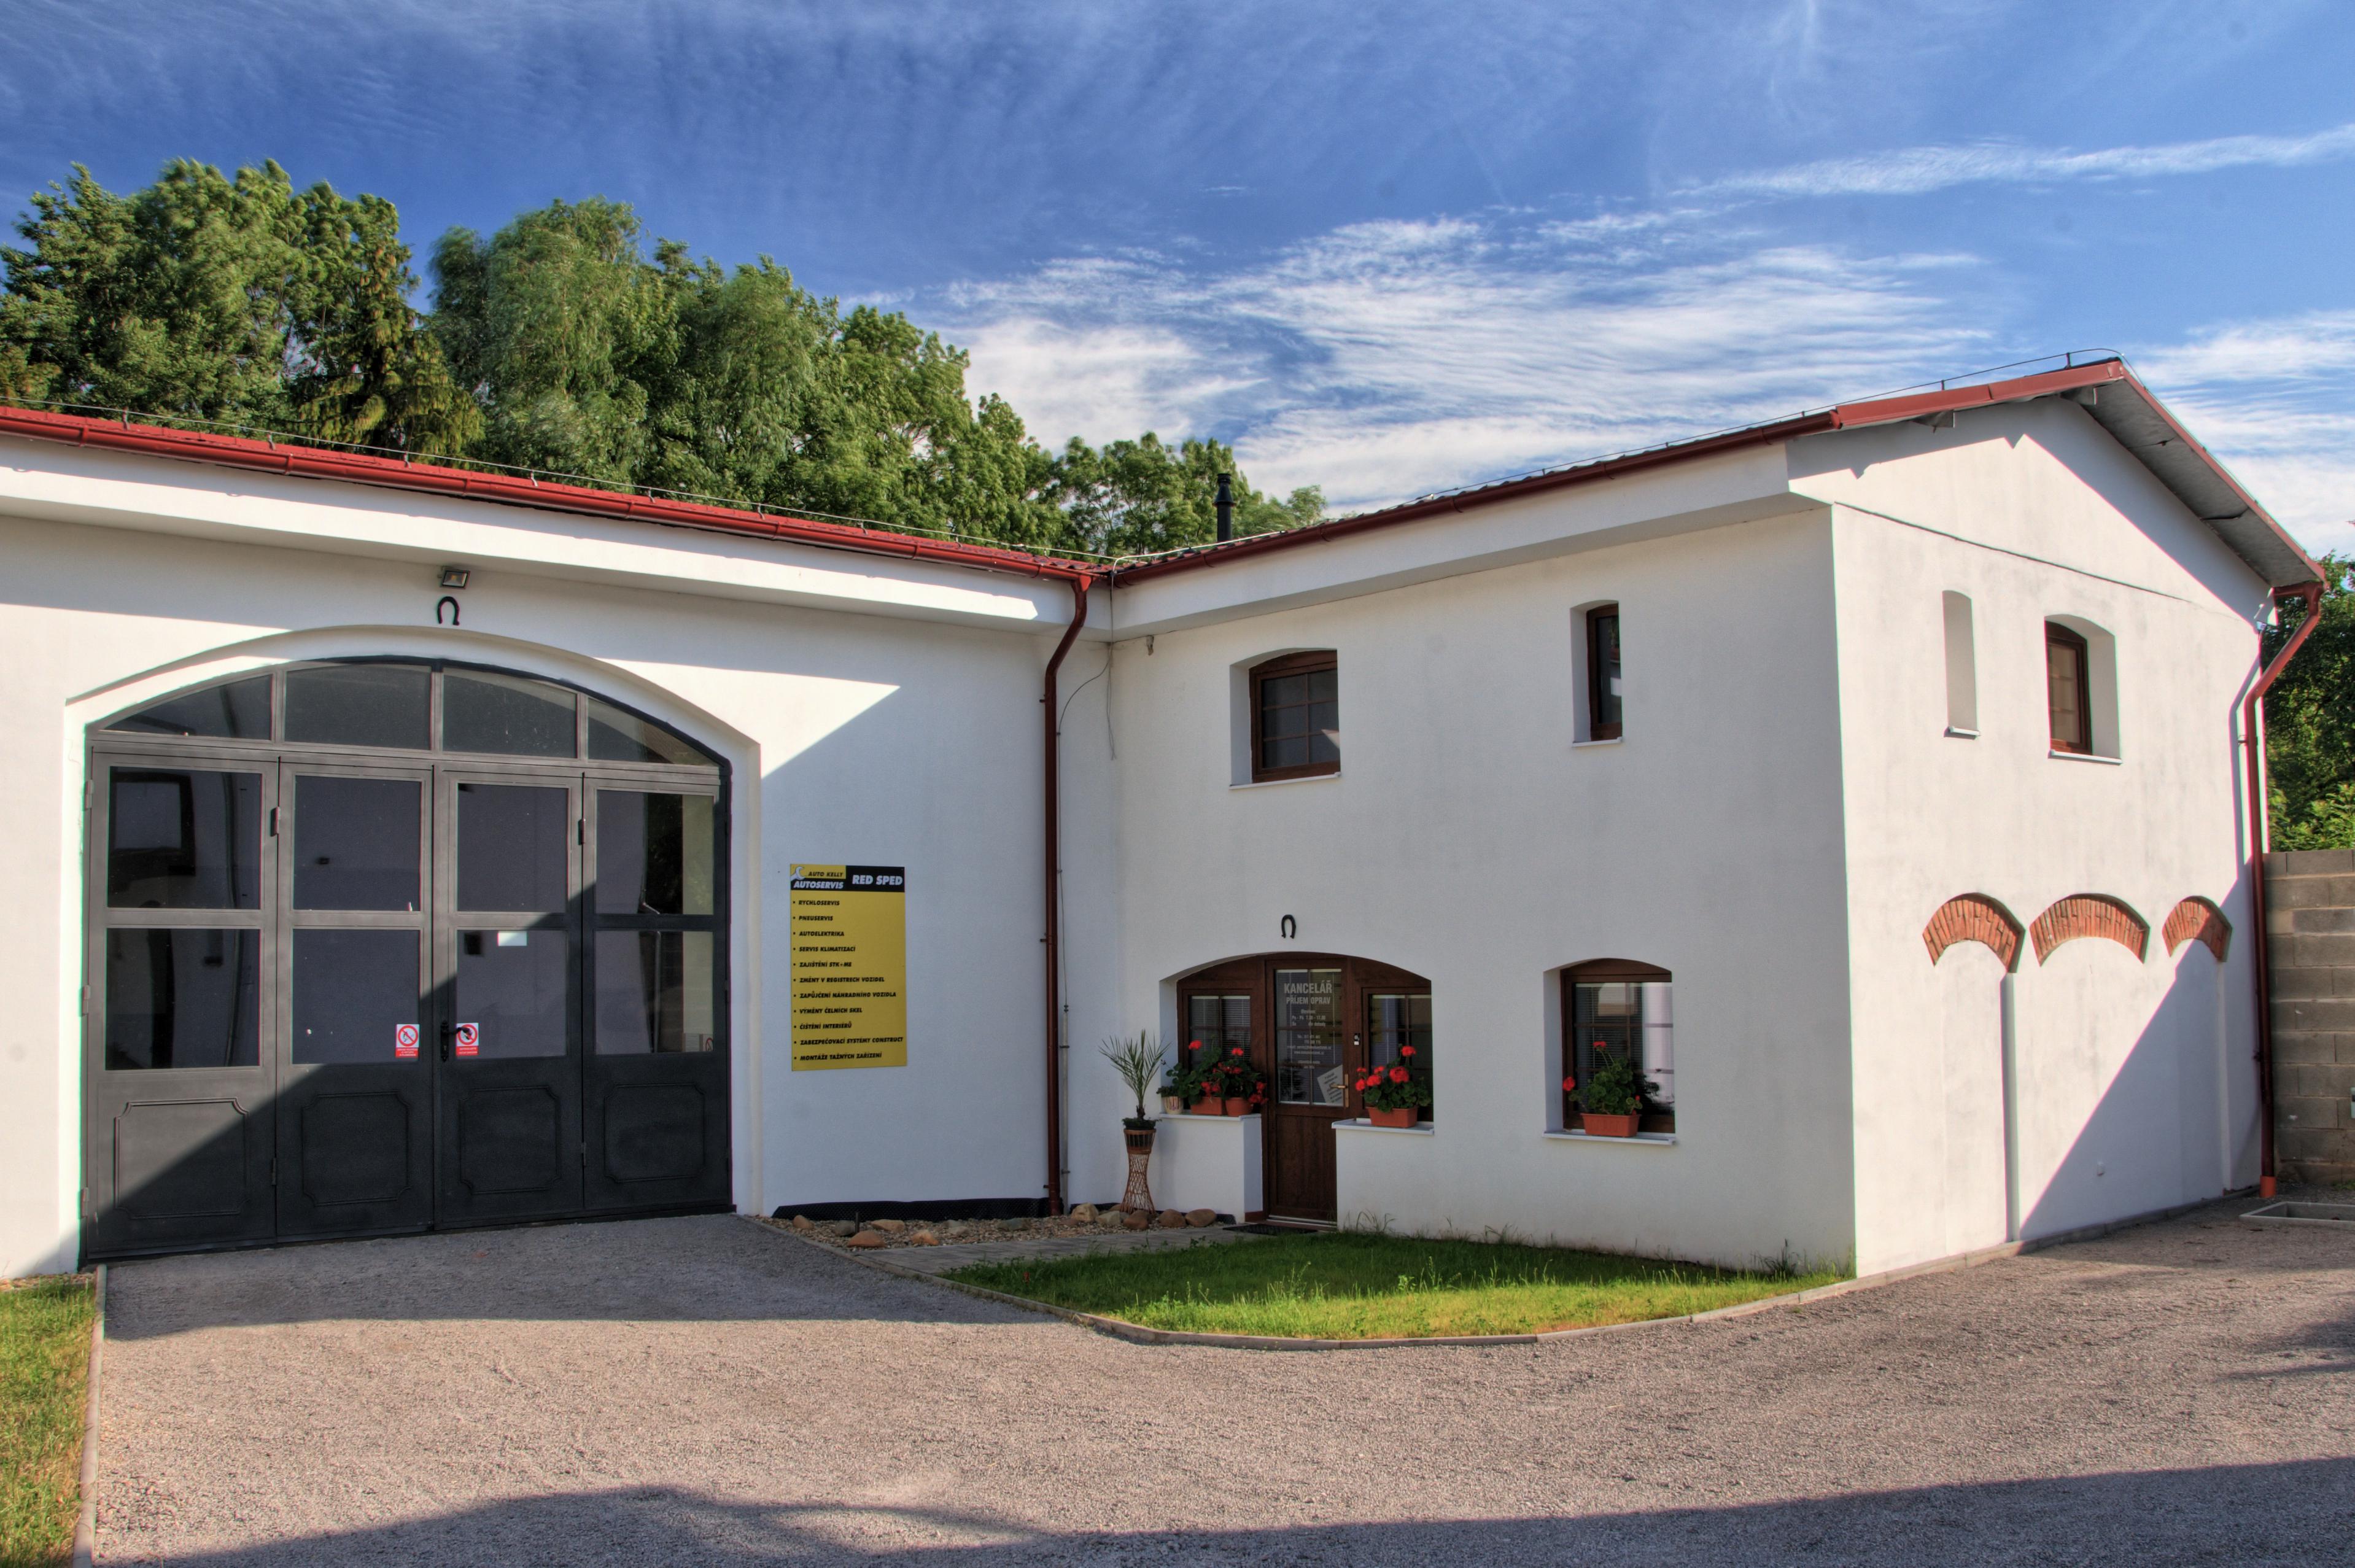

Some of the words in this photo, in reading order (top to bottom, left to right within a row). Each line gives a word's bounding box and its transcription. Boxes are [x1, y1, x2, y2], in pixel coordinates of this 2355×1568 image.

[852, 875, 874, 885] RED
[876, 875, 903, 885] SPED
[1284, 980, 1332, 993] KANCELÁŘ
[1286, 995, 1308, 1004] PŘÍJEM
